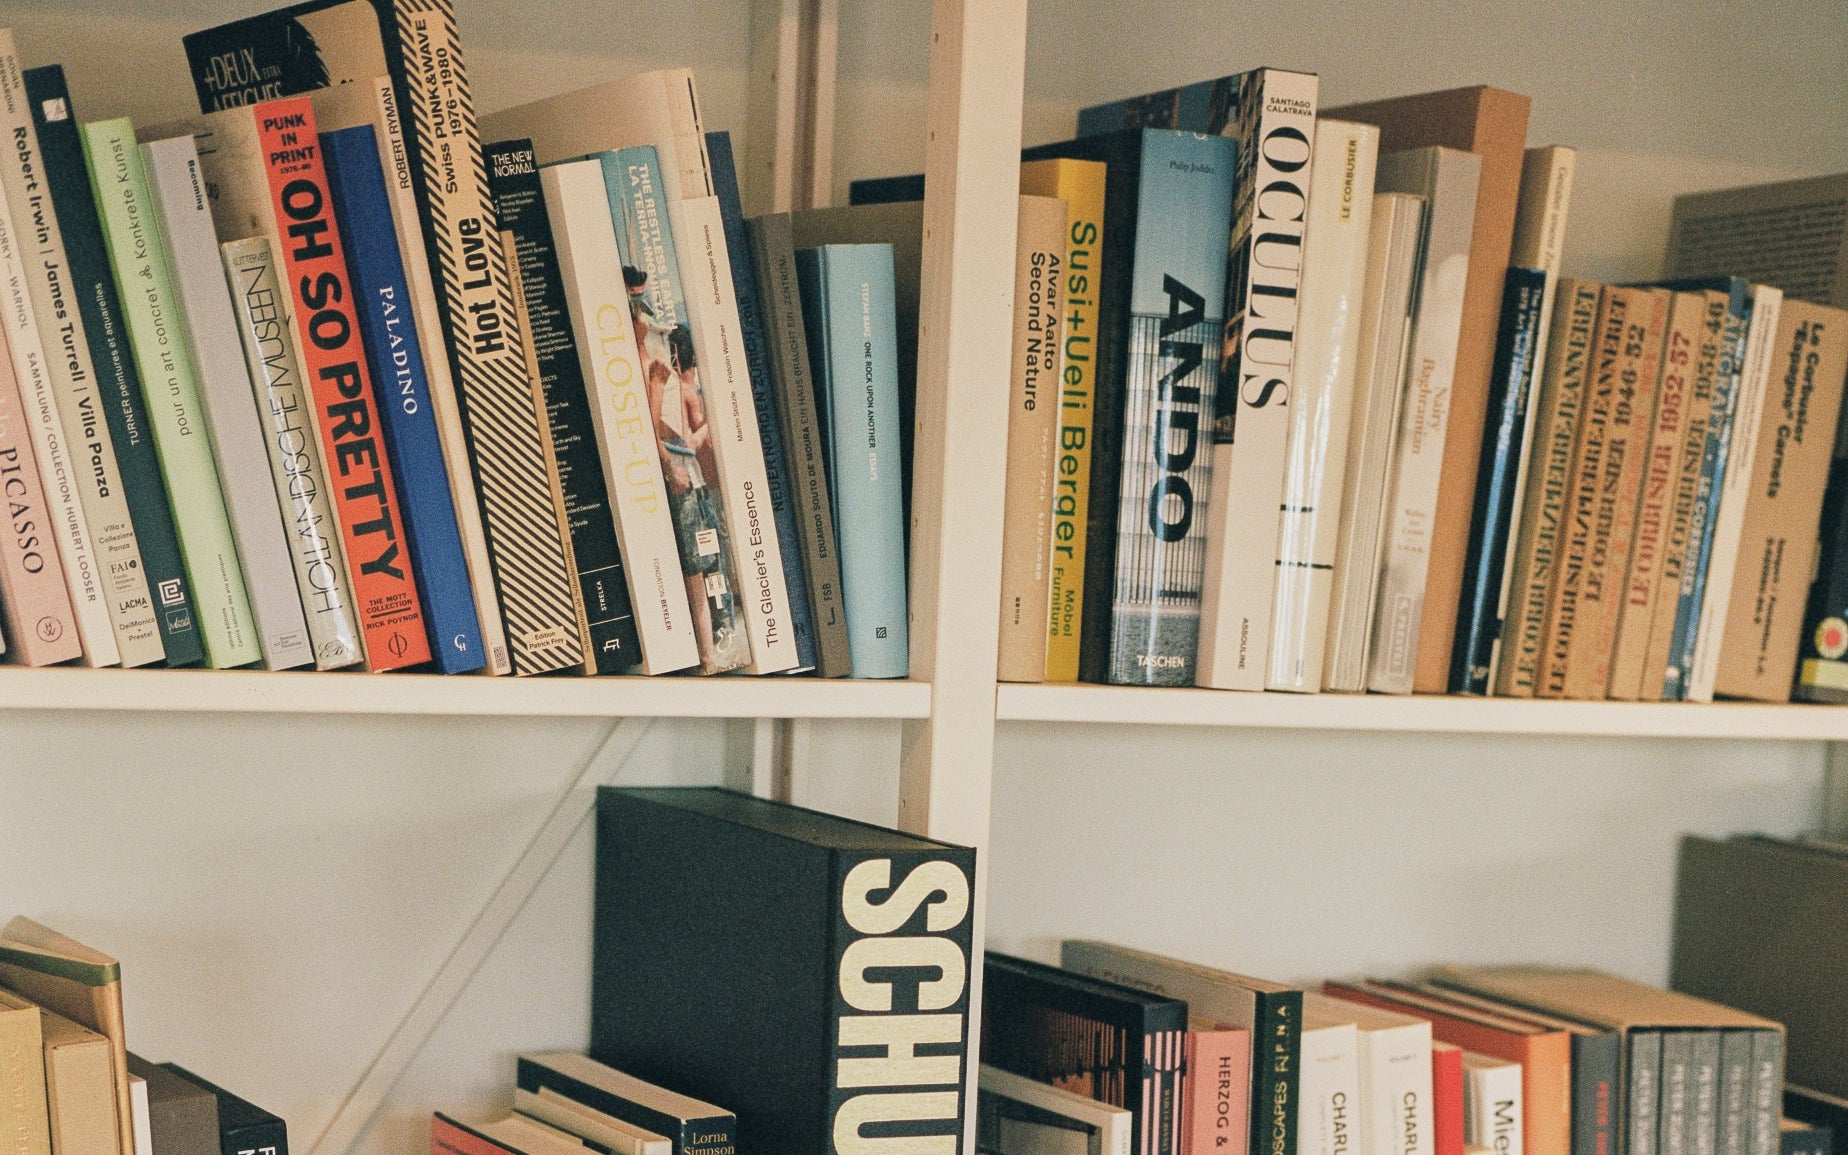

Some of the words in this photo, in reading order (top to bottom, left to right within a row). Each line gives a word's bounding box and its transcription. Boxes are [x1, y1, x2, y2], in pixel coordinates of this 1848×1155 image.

[414, 18, 448, 137] PUNK&WAVE
[263, 112, 307, 133] PUNK
[382, 87, 402, 134] RYMAN
[1267, 104, 1313, 117] CALATRAVA
[1270, 97, 1311, 109] SANTIAGO
[270, 146, 315, 164] PRINT
[281, 130, 298, 148] IN
[492, 153, 511, 166] THE
[512, 150, 533, 162] NEW
[187, 160, 204, 211] Becoming
[391, 137, 411, 190] ROBERT
[440, 142, 458, 195] Swiss
[494, 163, 536, 178] NORMAL
[637, 162, 652, 193] THE
[1340, 138, 1358, 202] CORBUSIER
[280, 178, 335, 263] OH
[643, 197, 668, 274] RESTLESS
[1339, 205, 1350, 218] LE
[458, 217, 493, 292] Love
[1048, 254, 1060, 303] Alvar
[1241, 127, 1310, 409] OCULUS
[13, 126, 38, 191] Robert
[29, 195, 50, 244] Irwin
[44, 260, 67, 319] James
[60, 321, 87, 382] Turrell
[78, 396, 95, 439] Villa
[89, 442, 110, 498] Panza
[95, 283, 115, 334] aquarelles
[300, 271, 351, 352] SO
[658, 279, 678, 330] EARTH
[859, 282, 870, 312] STEFAN
[1028, 252, 1045, 329] Second
[473, 299, 503, 354] Hot
[1061, 220, 1097, 410] Susi+Ueli
[1809, 322, 1824, 346] Le
[106, 336, 116, 348] et
[379, 286, 419, 416] PALADINO
[863, 342, 872, 358] ONE
[1044, 310, 1057, 370] Aalto
[112, 350, 130, 396] peintures
[863, 361, 873, 382] ROCK
[1024, 336, 1042, 411] Nature
[596, 304, 659, 515] CLOSE-UP
[865, 385, 874, 407] UPON
[1148, 272, 1205, 542] ANDO
[1792, 351, 1819, 445] Corbusier
[122, 399, 140, 446] TURNER
[865, 409, 878, 448] ANOTHER
[27, 352, 52, 425] SAMMLUNG
[47, 433, 72, 504] COLLECTION
[65, 506, 84, 552] HUBERT
[77, 554, 97, 602] LOOSER
[320, 365, 405, 581] PRETTY
[1050, 425, 1086, 558] Berger
[1, 446, 44, 575] PICASSO
[742, 480, 764, 546] Essence
[1632, 442, 1675, 574] CORBUSIER
[110, 562, 129, 574] FAI
[757, 550, 775, 614] Glacier's
[1627, 575, 1651, 607] LE
[120, 597, 149, 613] LACMA
[366, 598, 413, 614] COLLECTION
[368, 598, 383, 607] THE
[384, 593, 408, 604] MOTT
[596, 580, 608, 611] STRELKA
[653, 557, 665, 598] FONDATION
[659, 599, 672, 632] BEYELER
[1049, 567, 1064, 636] Furniture
[1061, 589, 1074, 637] Möbel
[366, 619, 386, 630] RICK
[387, 612, 419, 627] POYNOR
[529, 639, 550, 650] Patrick
[551, 636, 566, 647] Frey
[534, 631, 556, 641] Edition
[764, 616, 778, 648] The
[1136, 654, 1186, 668] TASCHEN
[1216, 1056, 1231, 1129] HERZOG
[693, 1132, 727, 1144] Lorna
[1216, 1135, 1228, 1147] &
